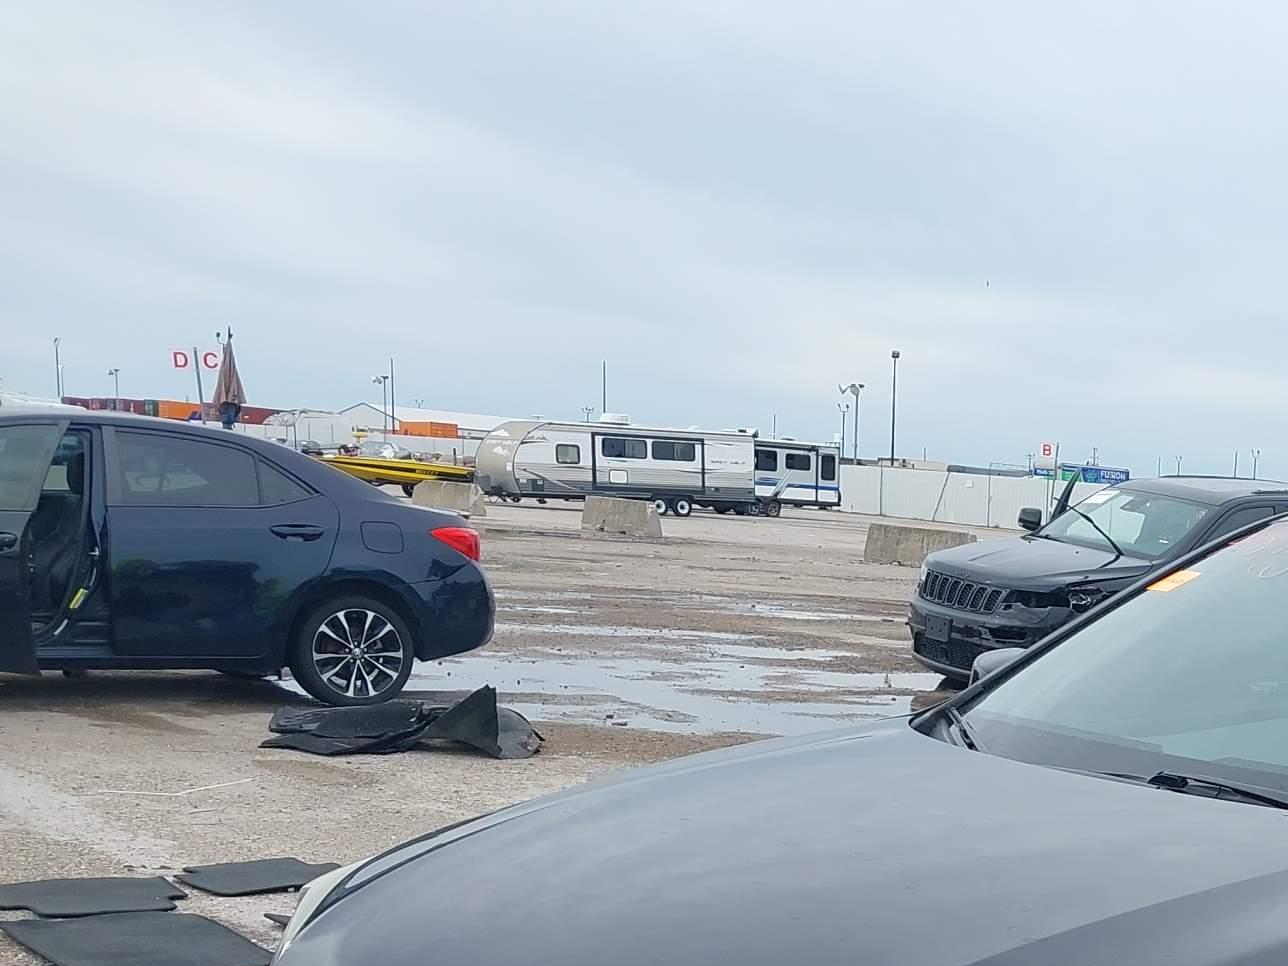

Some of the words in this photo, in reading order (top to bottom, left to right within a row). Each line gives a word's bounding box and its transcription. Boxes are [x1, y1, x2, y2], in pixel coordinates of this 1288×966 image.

[173, 351, 188, 368] D
[203, 352, 218, 369] C
[1043, 444, 1051, 456] B
[1100, 471, 1126, 480] FUSION
